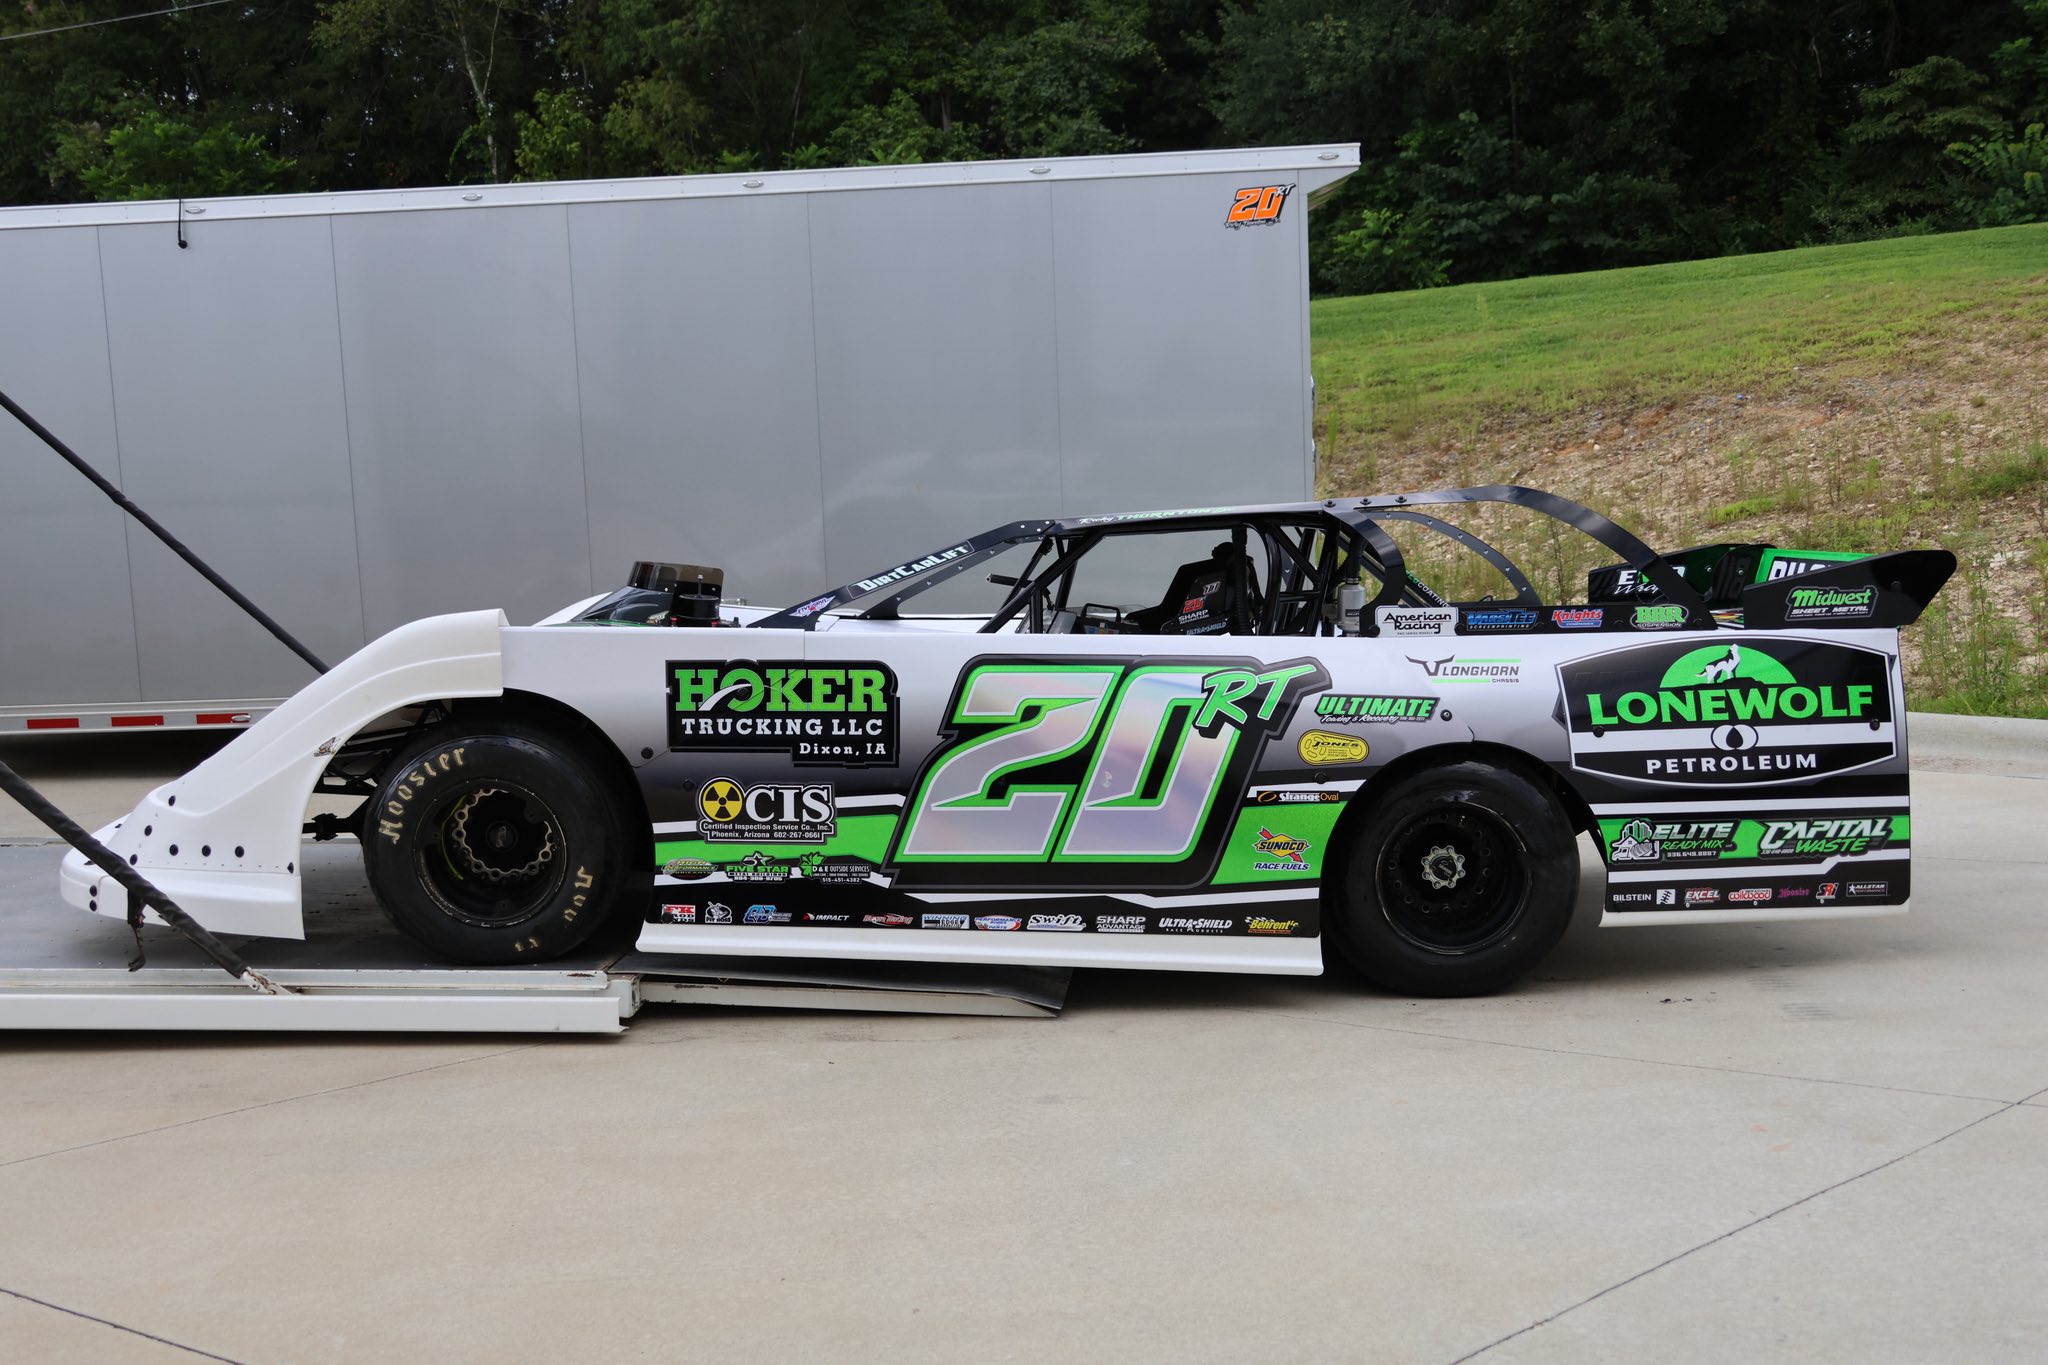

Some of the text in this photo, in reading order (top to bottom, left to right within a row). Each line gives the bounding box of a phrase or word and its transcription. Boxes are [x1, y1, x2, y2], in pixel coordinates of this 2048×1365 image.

[1791, 589, 1872, 607] Midwest
[1178, 609, 1208, 622] SHARP
[1384, 611, 1451, 622] American
[1553, 609, 1602, 625] Knights
[1635, 606, 1685, 623] BBR
[1394, 620, 1441, 634] Racing
[1443, 666, 1519, 677] LONGHORN
[675, 668, 887, 712] HOKER
[1316, 696, 1436, 718] ULTIMATE
[1586, 684, 1873, 726] LONEWOLF
[1320, 714, 1352, 723] Towing
[1358, 714, 1400, 723] Recovery
[681, 718, 883, 736] TRUCKING LLC
[800, 743, 886, 756] Dixon, IA
[1646, 753, 1817, 774] PETROLEUM
[745, 788, 831, 823] CIS
[735, 823, 771, 832] Inspection
[1651, 822, 1734, 840] ELITE
[1760, 818, 1888, 849] CAPITAL
[1258, 841, 1305, 851] SUNOCO
[1660, 840, 1702, 850] READY
[1700, 840, 1725, 849] MIX
[1795, 838, 1870, 853] WASTE
[1254, 862, 1310, 871] RACE FUELS
[1685, 890, 1720, 900] EXCEL
[1030, 915, 1082, 926] Swift
[1096, 916, 1146, 924] SHARP
